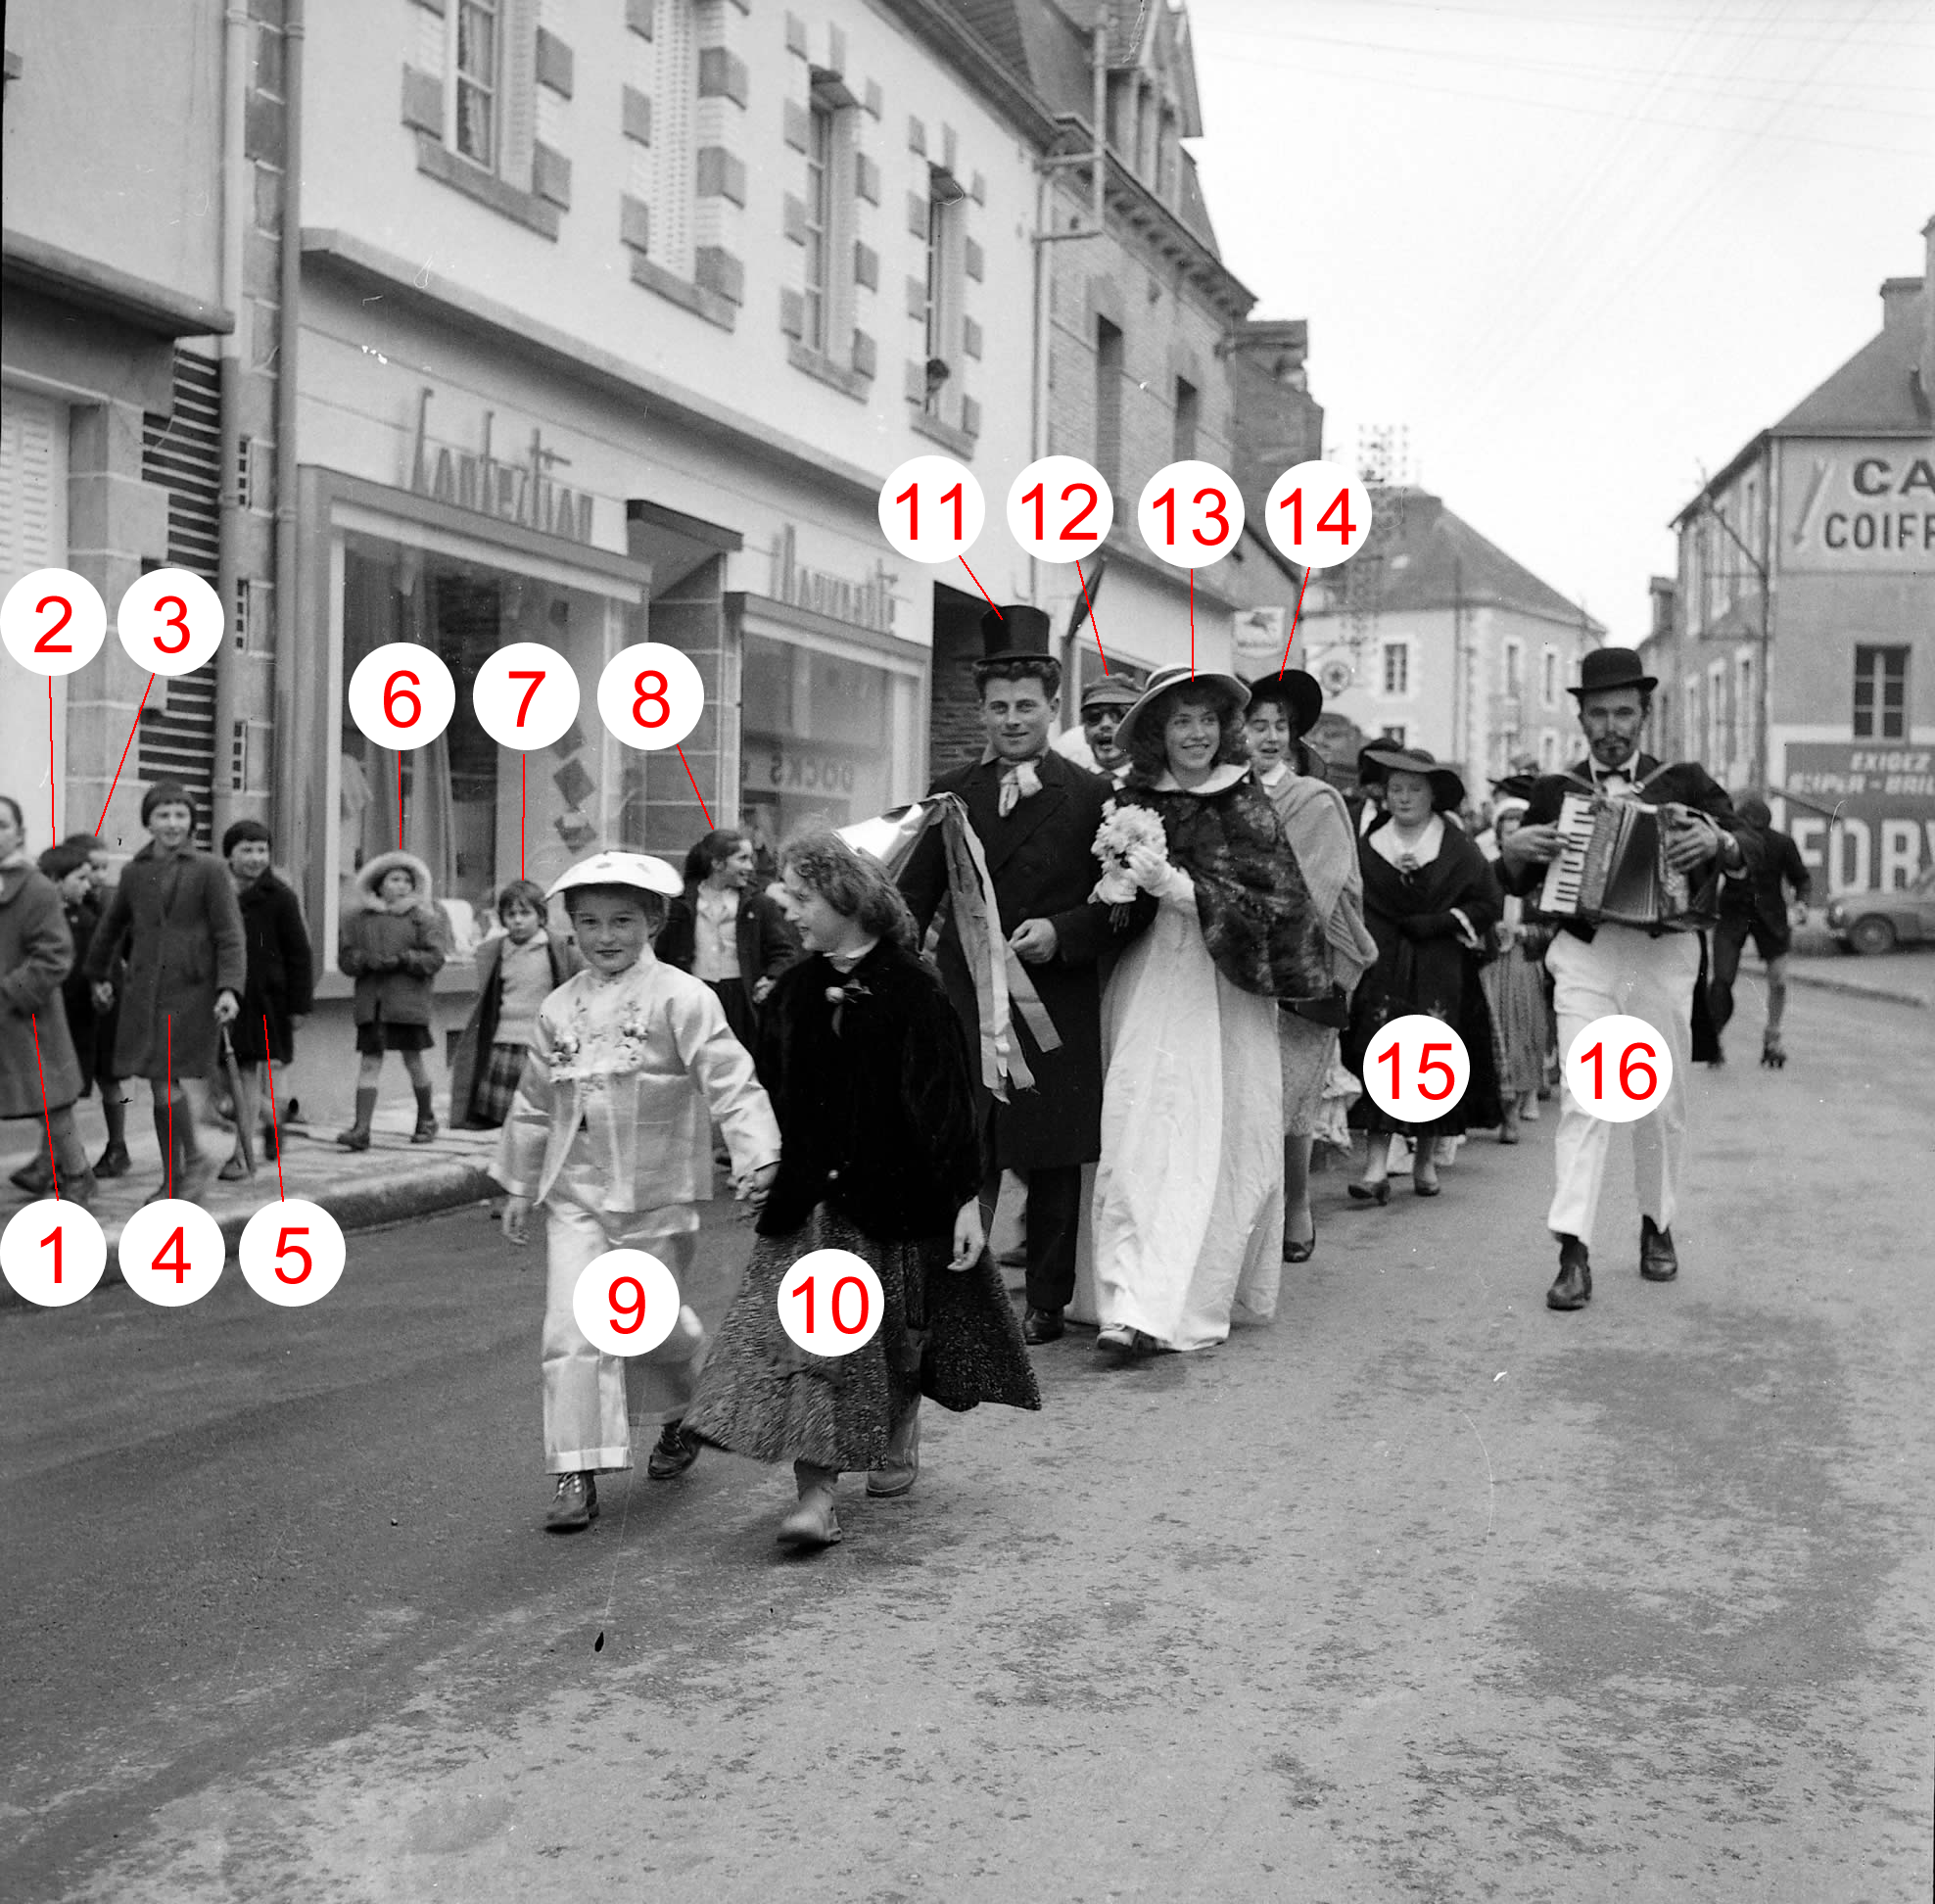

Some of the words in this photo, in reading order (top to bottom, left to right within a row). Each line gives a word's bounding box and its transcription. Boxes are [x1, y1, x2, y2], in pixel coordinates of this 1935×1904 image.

[1854, 457, 1935, 496] CA
[1825, 512, 1935, 550] COIFF
[1851, 751, 1931, 773] EXIGEZ
